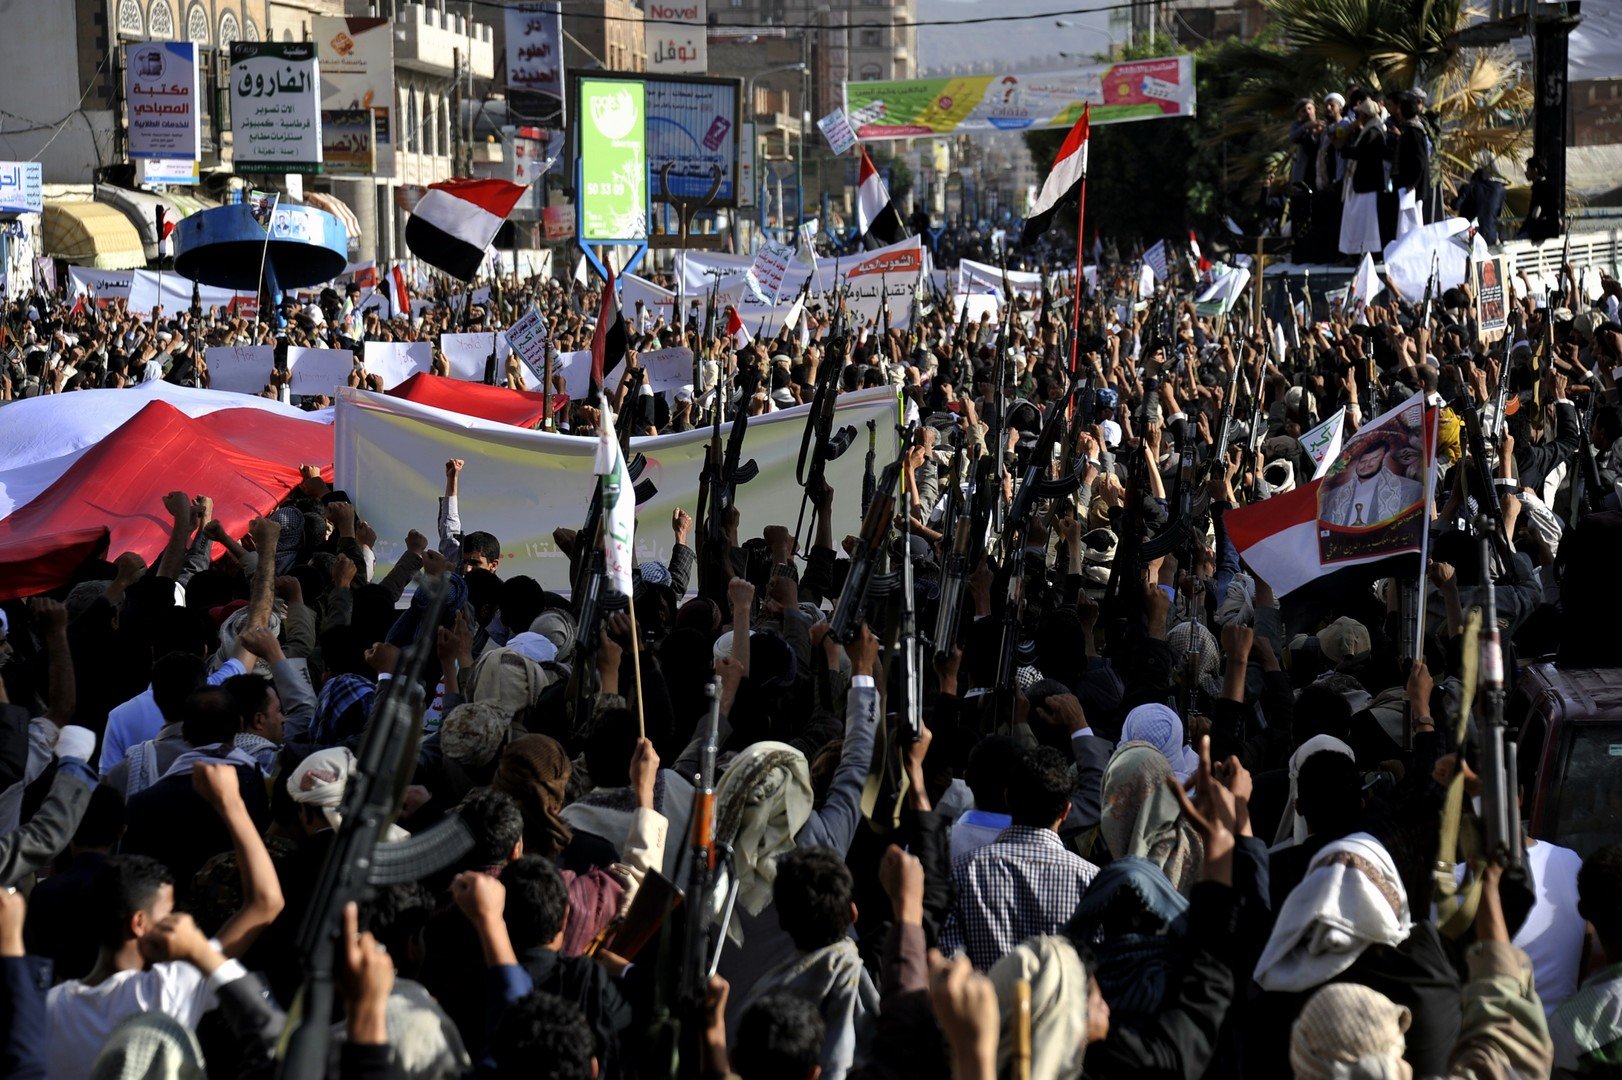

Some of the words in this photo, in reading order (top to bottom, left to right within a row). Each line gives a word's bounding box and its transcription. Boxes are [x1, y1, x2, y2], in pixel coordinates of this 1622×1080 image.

[651, 5, 697, 19] Novel
[524, 19, 542, 36] دار
[518, 43, 551, 62] العلوم
[654, 40, 696, 64] نوفل
[238, 65, 311, 97] الفاروق
[133, 83, 189, 98] مكتبة
[134, 102, 189, 116] المصباحي
[255, 104, 280, 115] تصوير
[161, 121, 189, 129] للخدمات
[241, 118, 274, 129] كمبيوتر
